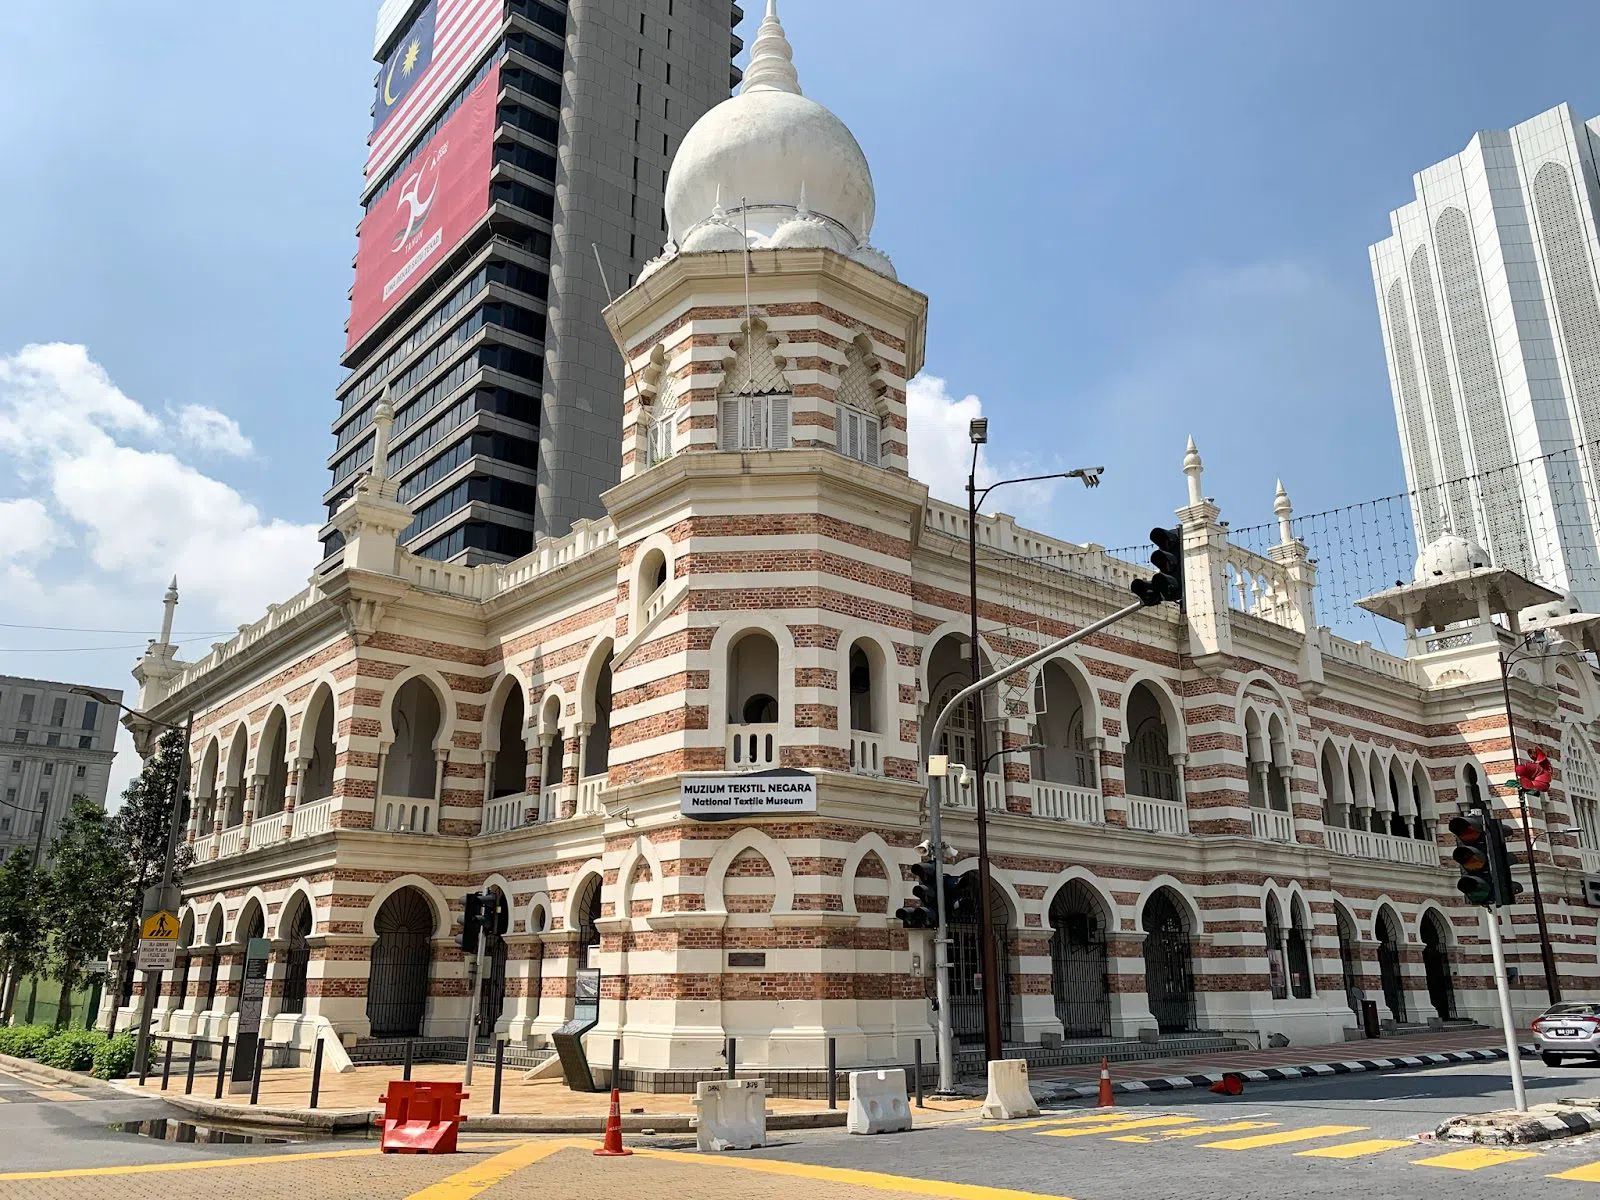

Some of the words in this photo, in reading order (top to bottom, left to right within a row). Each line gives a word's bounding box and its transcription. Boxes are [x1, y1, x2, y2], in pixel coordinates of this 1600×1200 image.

[684, 784, 725, 794] MUZIUM
[727, 784, 766, 793] TEKSTIL
[768, 783, 812, 793] NEGARA
[692, 797, 731, 806] National
[733, 796, 764, 806] Textile
[765, 796, 803, 806] Museum
